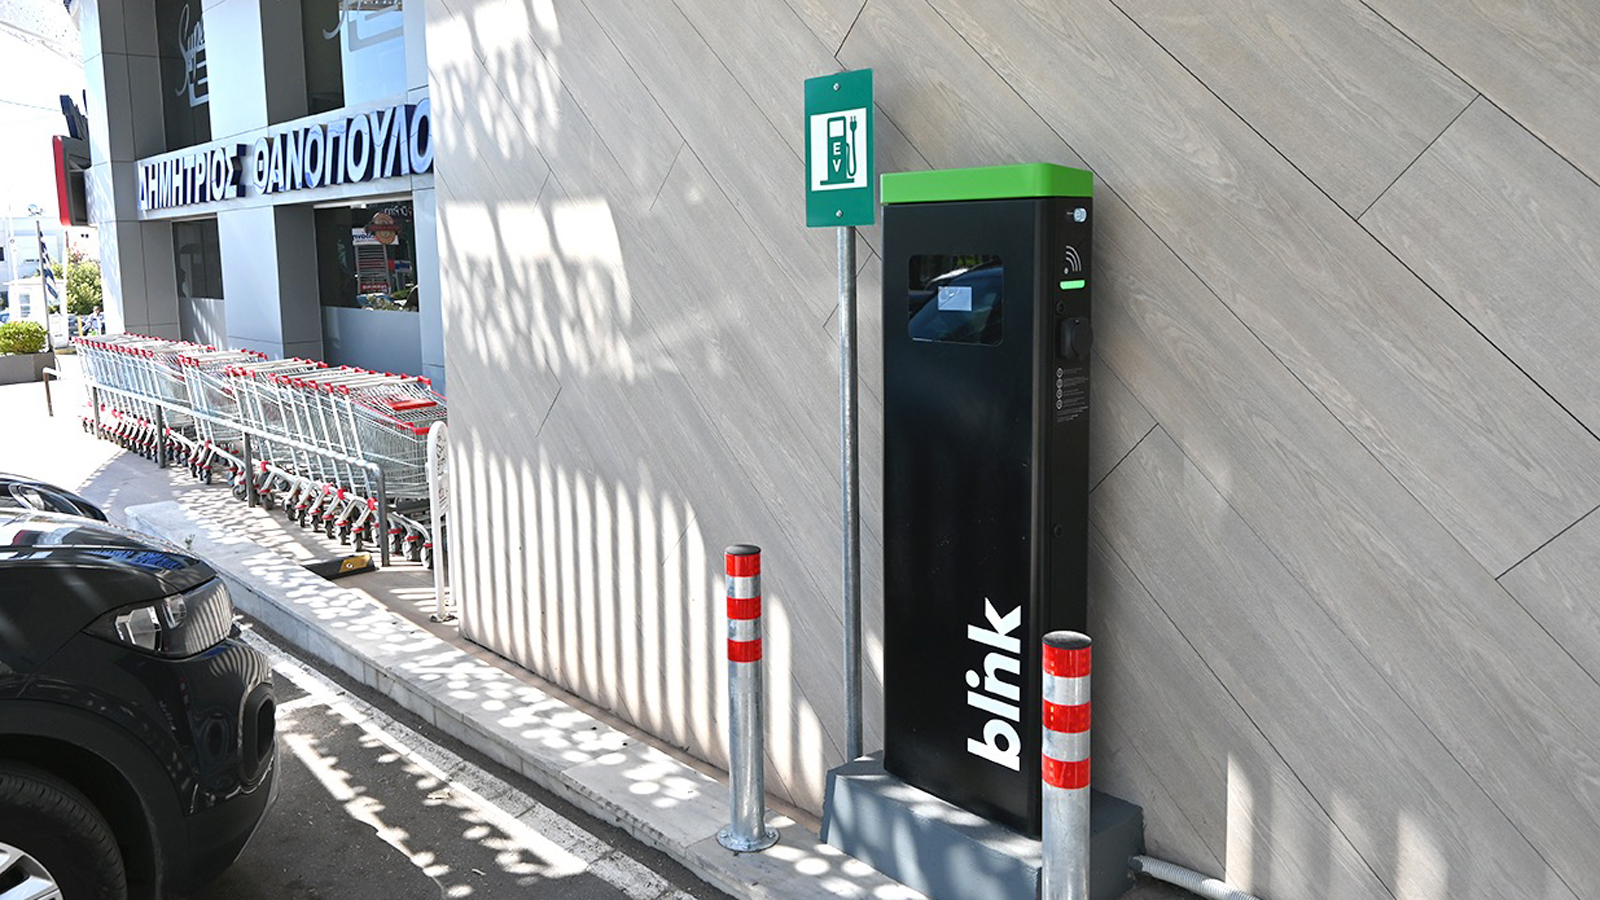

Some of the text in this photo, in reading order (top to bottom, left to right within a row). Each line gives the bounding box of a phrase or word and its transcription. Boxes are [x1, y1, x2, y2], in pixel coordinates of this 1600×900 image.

[138, 145, 243, 211] ΔΗΜΗΤΡΙΟΣ
[832, 141, 841, 173] EV
[965, 596, 1021, 772] blink
